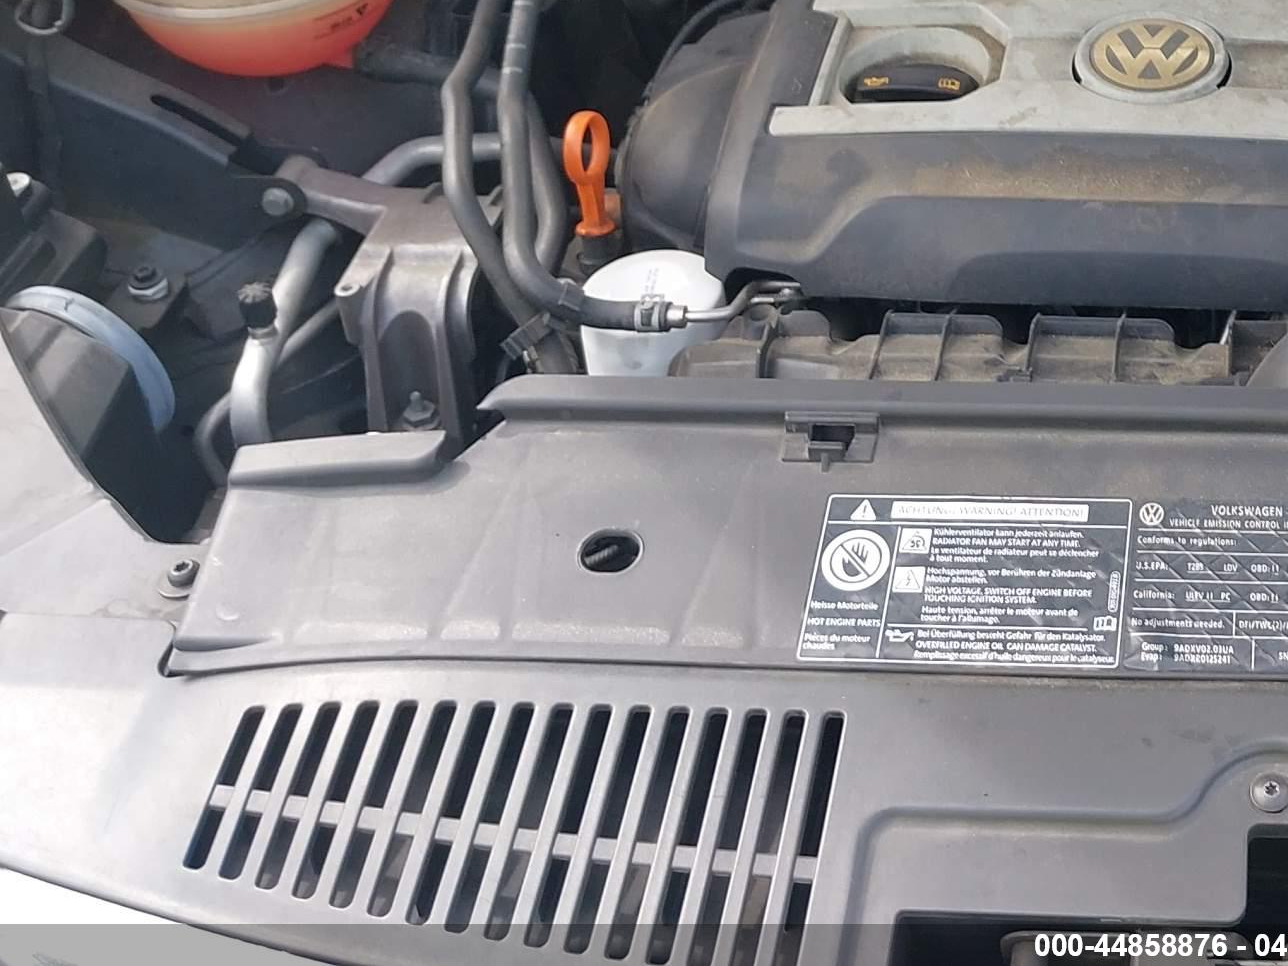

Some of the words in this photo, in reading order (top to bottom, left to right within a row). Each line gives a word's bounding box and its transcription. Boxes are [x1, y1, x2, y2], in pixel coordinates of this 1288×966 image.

[960, 506, 1016, 516] WARNING!
[1020, 507, 1084, 518] ATTENTION!
[1211, 504, 1283, 517] VOLKSWAGEN
[1169, 518, 1200, 527] VEHICLE
[1204, 519, 1241, 529] EMISSION
[1244, 520, 1280, 529] CONTROL
[932, 537, 971, 545] RADIATOR
[988, 538, 1006, 546] MAY
[1042, 539, 1059, 547] ANY
[1060, 540, 1081, 548] TIME.
[1137, 535, 1174, 545] Conforms
[1178, 536, 1186, 544] to
[1190, 537, 1237, 547] regulations:
[931, 547, 940, 555] Le
[994, 548, 1028, 556] radiateur
[1030, 549, 1048, 557] peut
[954, 555, 988, 563] moment.
[1037, 569, 1051, 577] der
[926, 575, 951, 583] Motor
[925, 586, 946, 594] HIGH
[984, 587, 1015, 595] SWITCH
[1032, 588, 1062, 597] ENGINE
[1063, 589, 1093, 597] BEFORE
[1133, 589, 1175, 599] California:
[924, 594, 966, 602] TOUCHING
[967, 595, 1004, 603] IGNITION
[1005, 596, 1037, 604] SYSTEM.
[922, 606, 946, 614] Haute
[1007, 607, 1015, 615] le
[1015, 607, 1044, 616] moteur
[1045, 608, 1067, 616] avant
[1068, 608, 1079, 617] de
[825, 618, 856, 626] ENGINE
[857, 619, 881, 627] PARTS
[1131, 618, 1143, 626] No
[1144, 618, 1192, 629] adjustments
[1194, 619, 1225, 629] needed.
[829, 633, 840, 642] du
[841, 634, 870, 643] moteur
[917, 629, 930, 637] Bei
[1005, 631, 1033, 640] Gefahr
[1046, 632, 1061, 641] den
[915, 640, 960, 649] OVERFILLED
[961, 641, 990, 650] ENGINE
[1006, 643, 1023, 651] CAN
[1025, 643, 1059, 651] DAMAGE
[1060, 644, 1097, 652] CATALYST.
